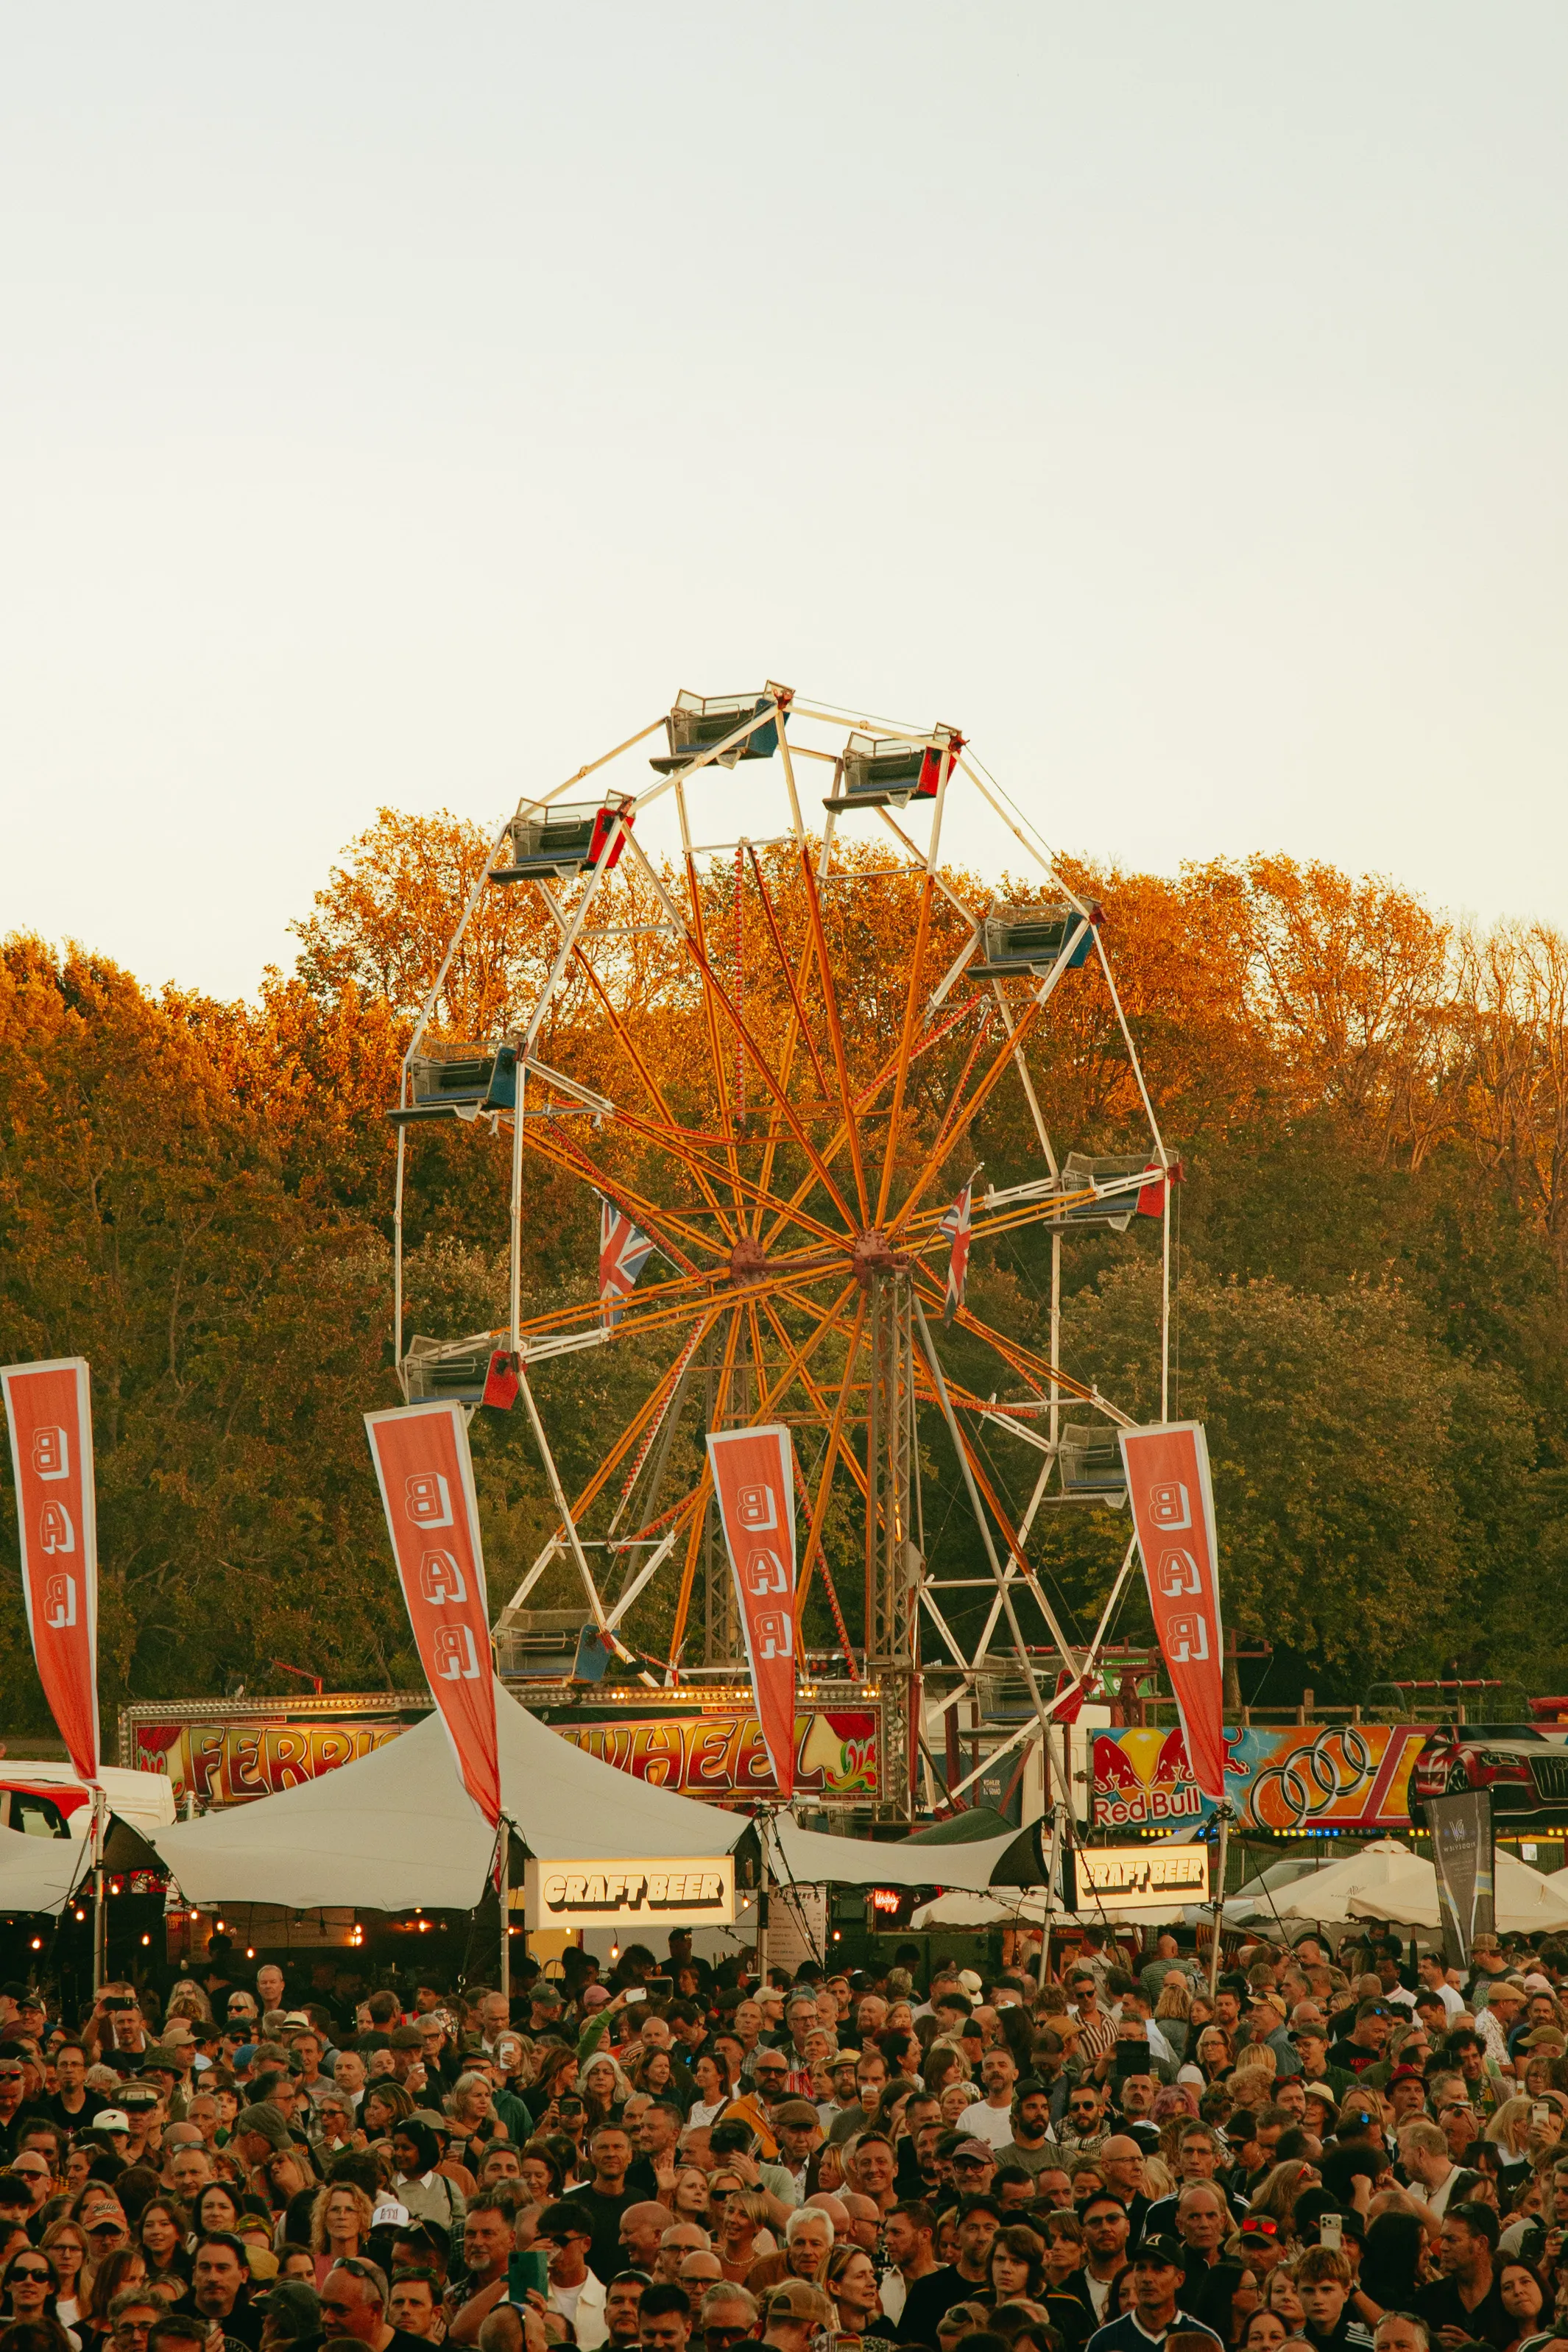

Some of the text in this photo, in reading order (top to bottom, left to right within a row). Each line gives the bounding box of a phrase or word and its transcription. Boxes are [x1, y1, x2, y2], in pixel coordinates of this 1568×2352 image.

[188, 1726, 406, 1798] FERR
[1094, 1785, 1201, 1826] Red Bull
[543, 1873, 724, 1913] CRAFT BEER
[1079, 1857, 1204, 1897] CRAFT BEER
